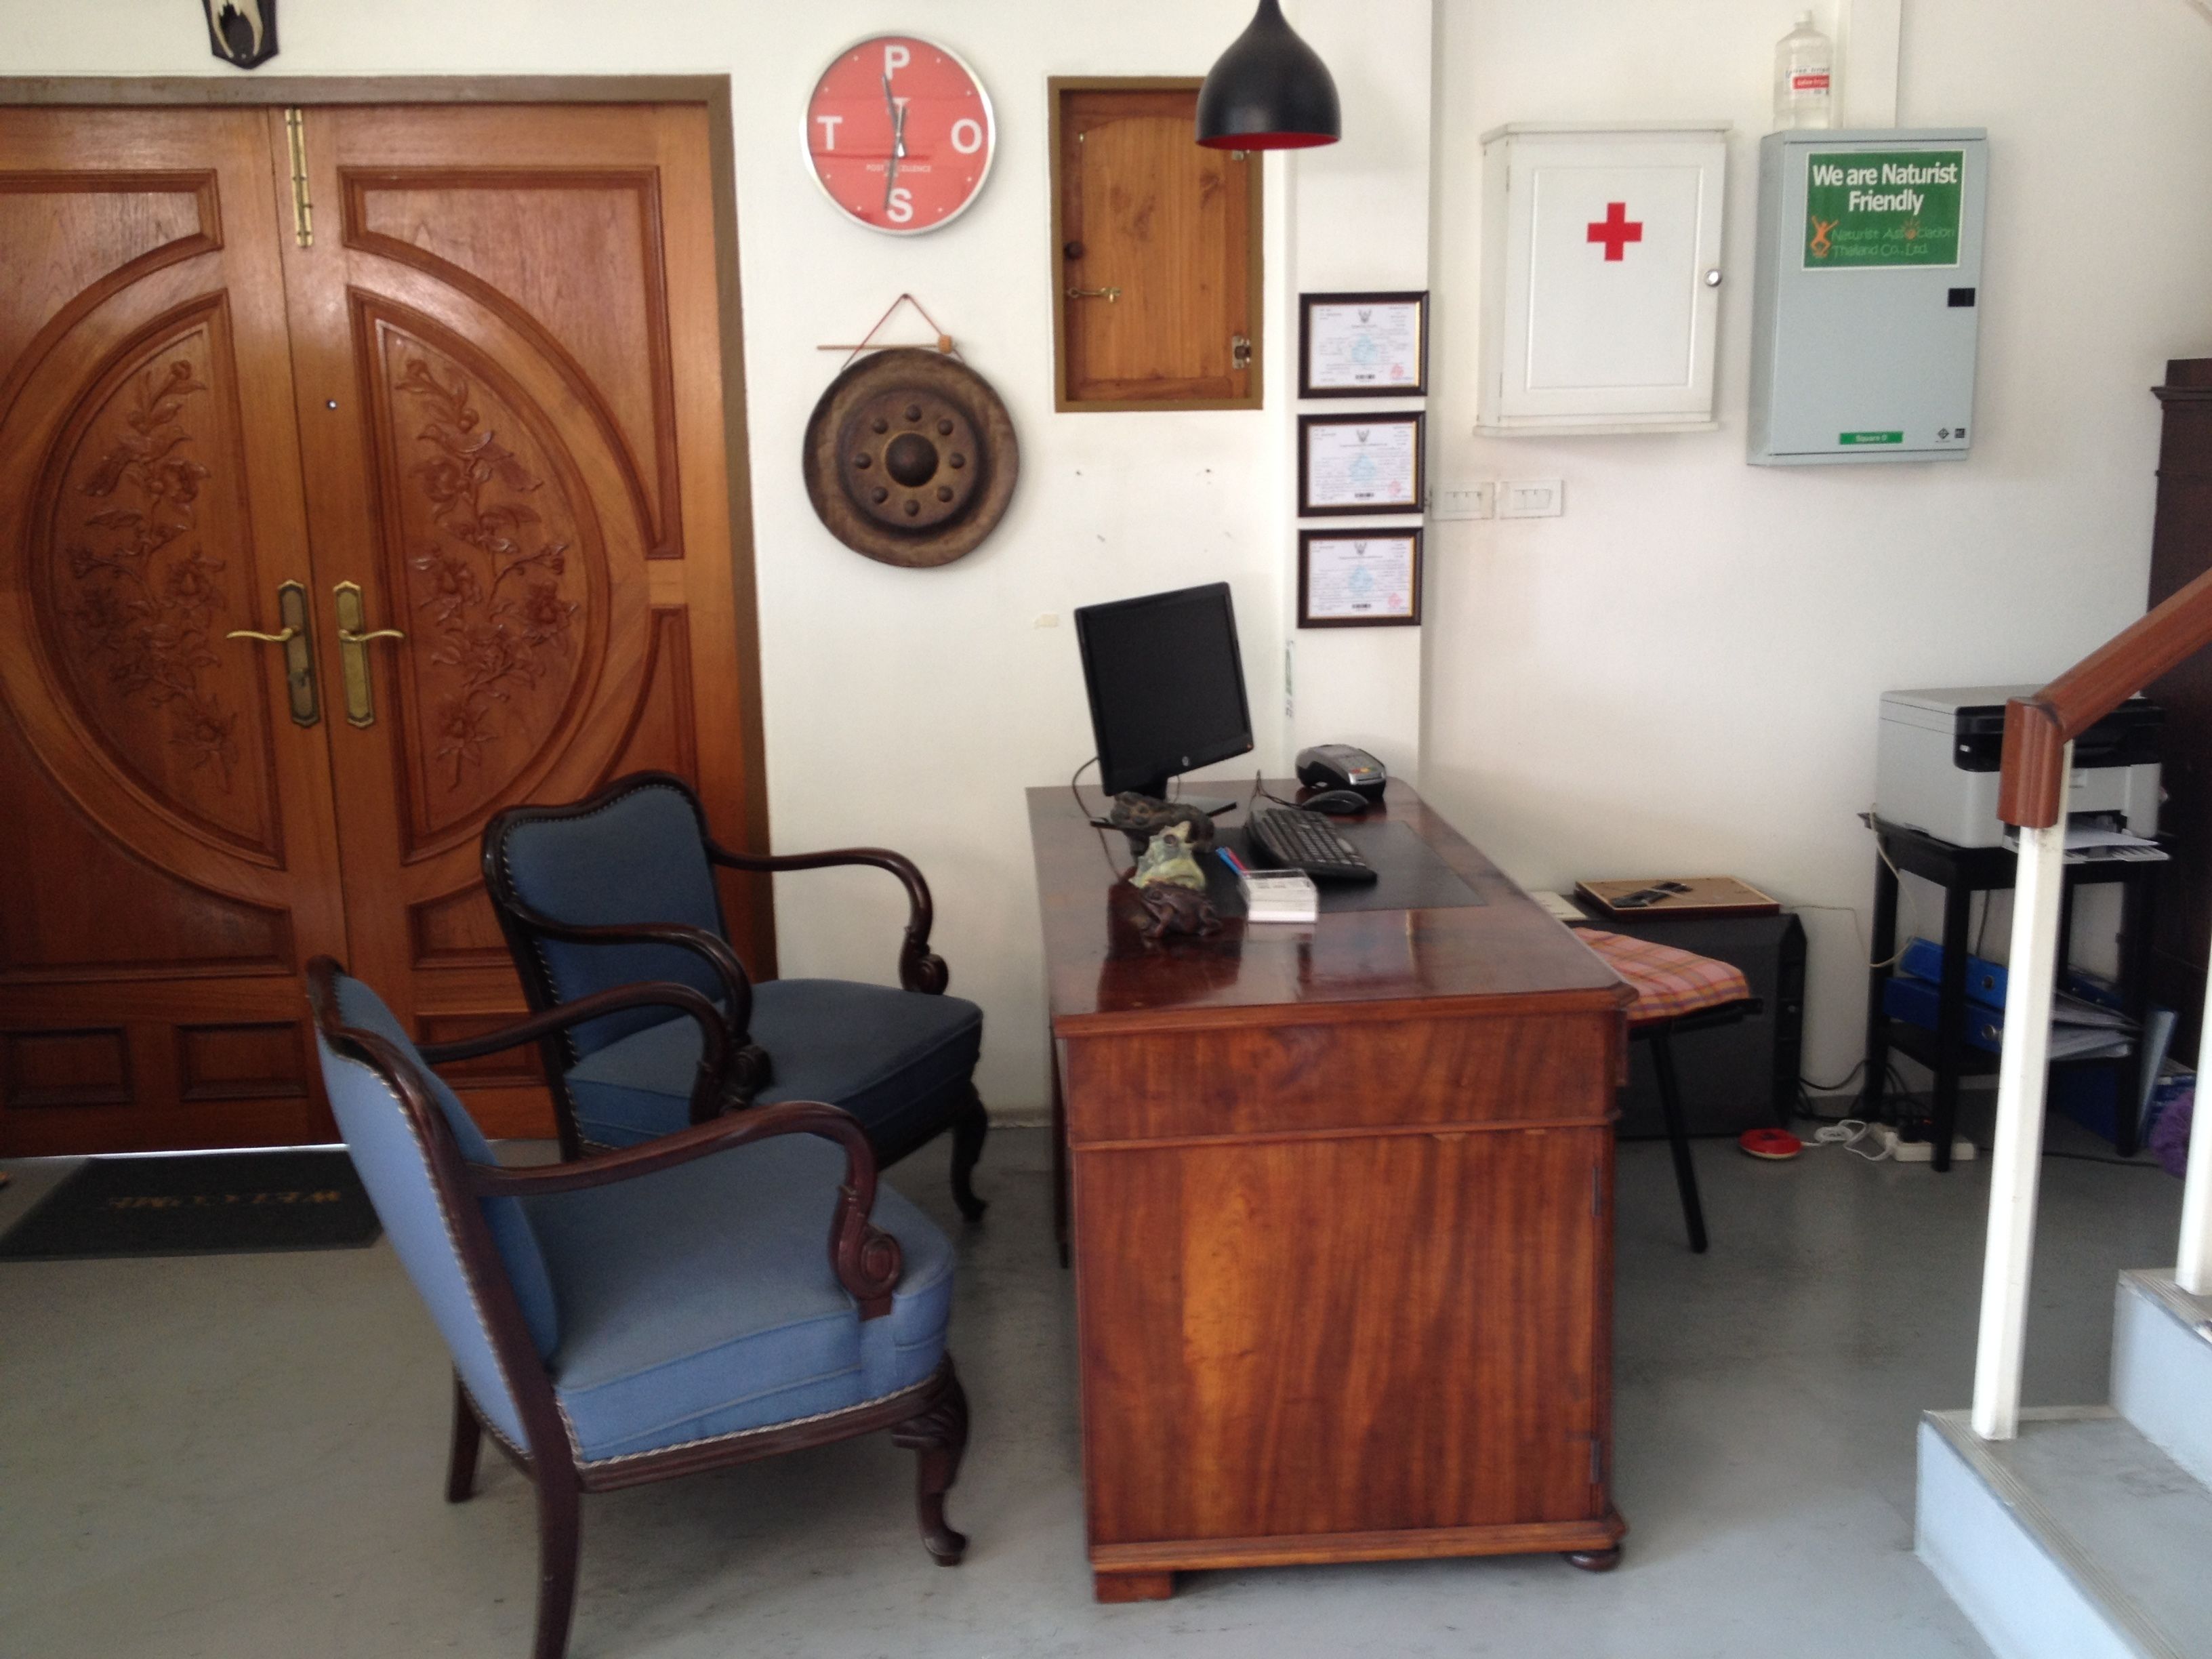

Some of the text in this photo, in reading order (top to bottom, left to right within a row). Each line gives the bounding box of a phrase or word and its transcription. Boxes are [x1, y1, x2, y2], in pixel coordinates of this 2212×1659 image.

[884, 45, 911, 81] P
[816, 115, 843, 151] T
[950, 118, 983, 155] O
[1811, 161, 1959, 186] We are Naturist
[886, 187, 914, 223] S
[1848, 188, 1925, 216] Friendly
